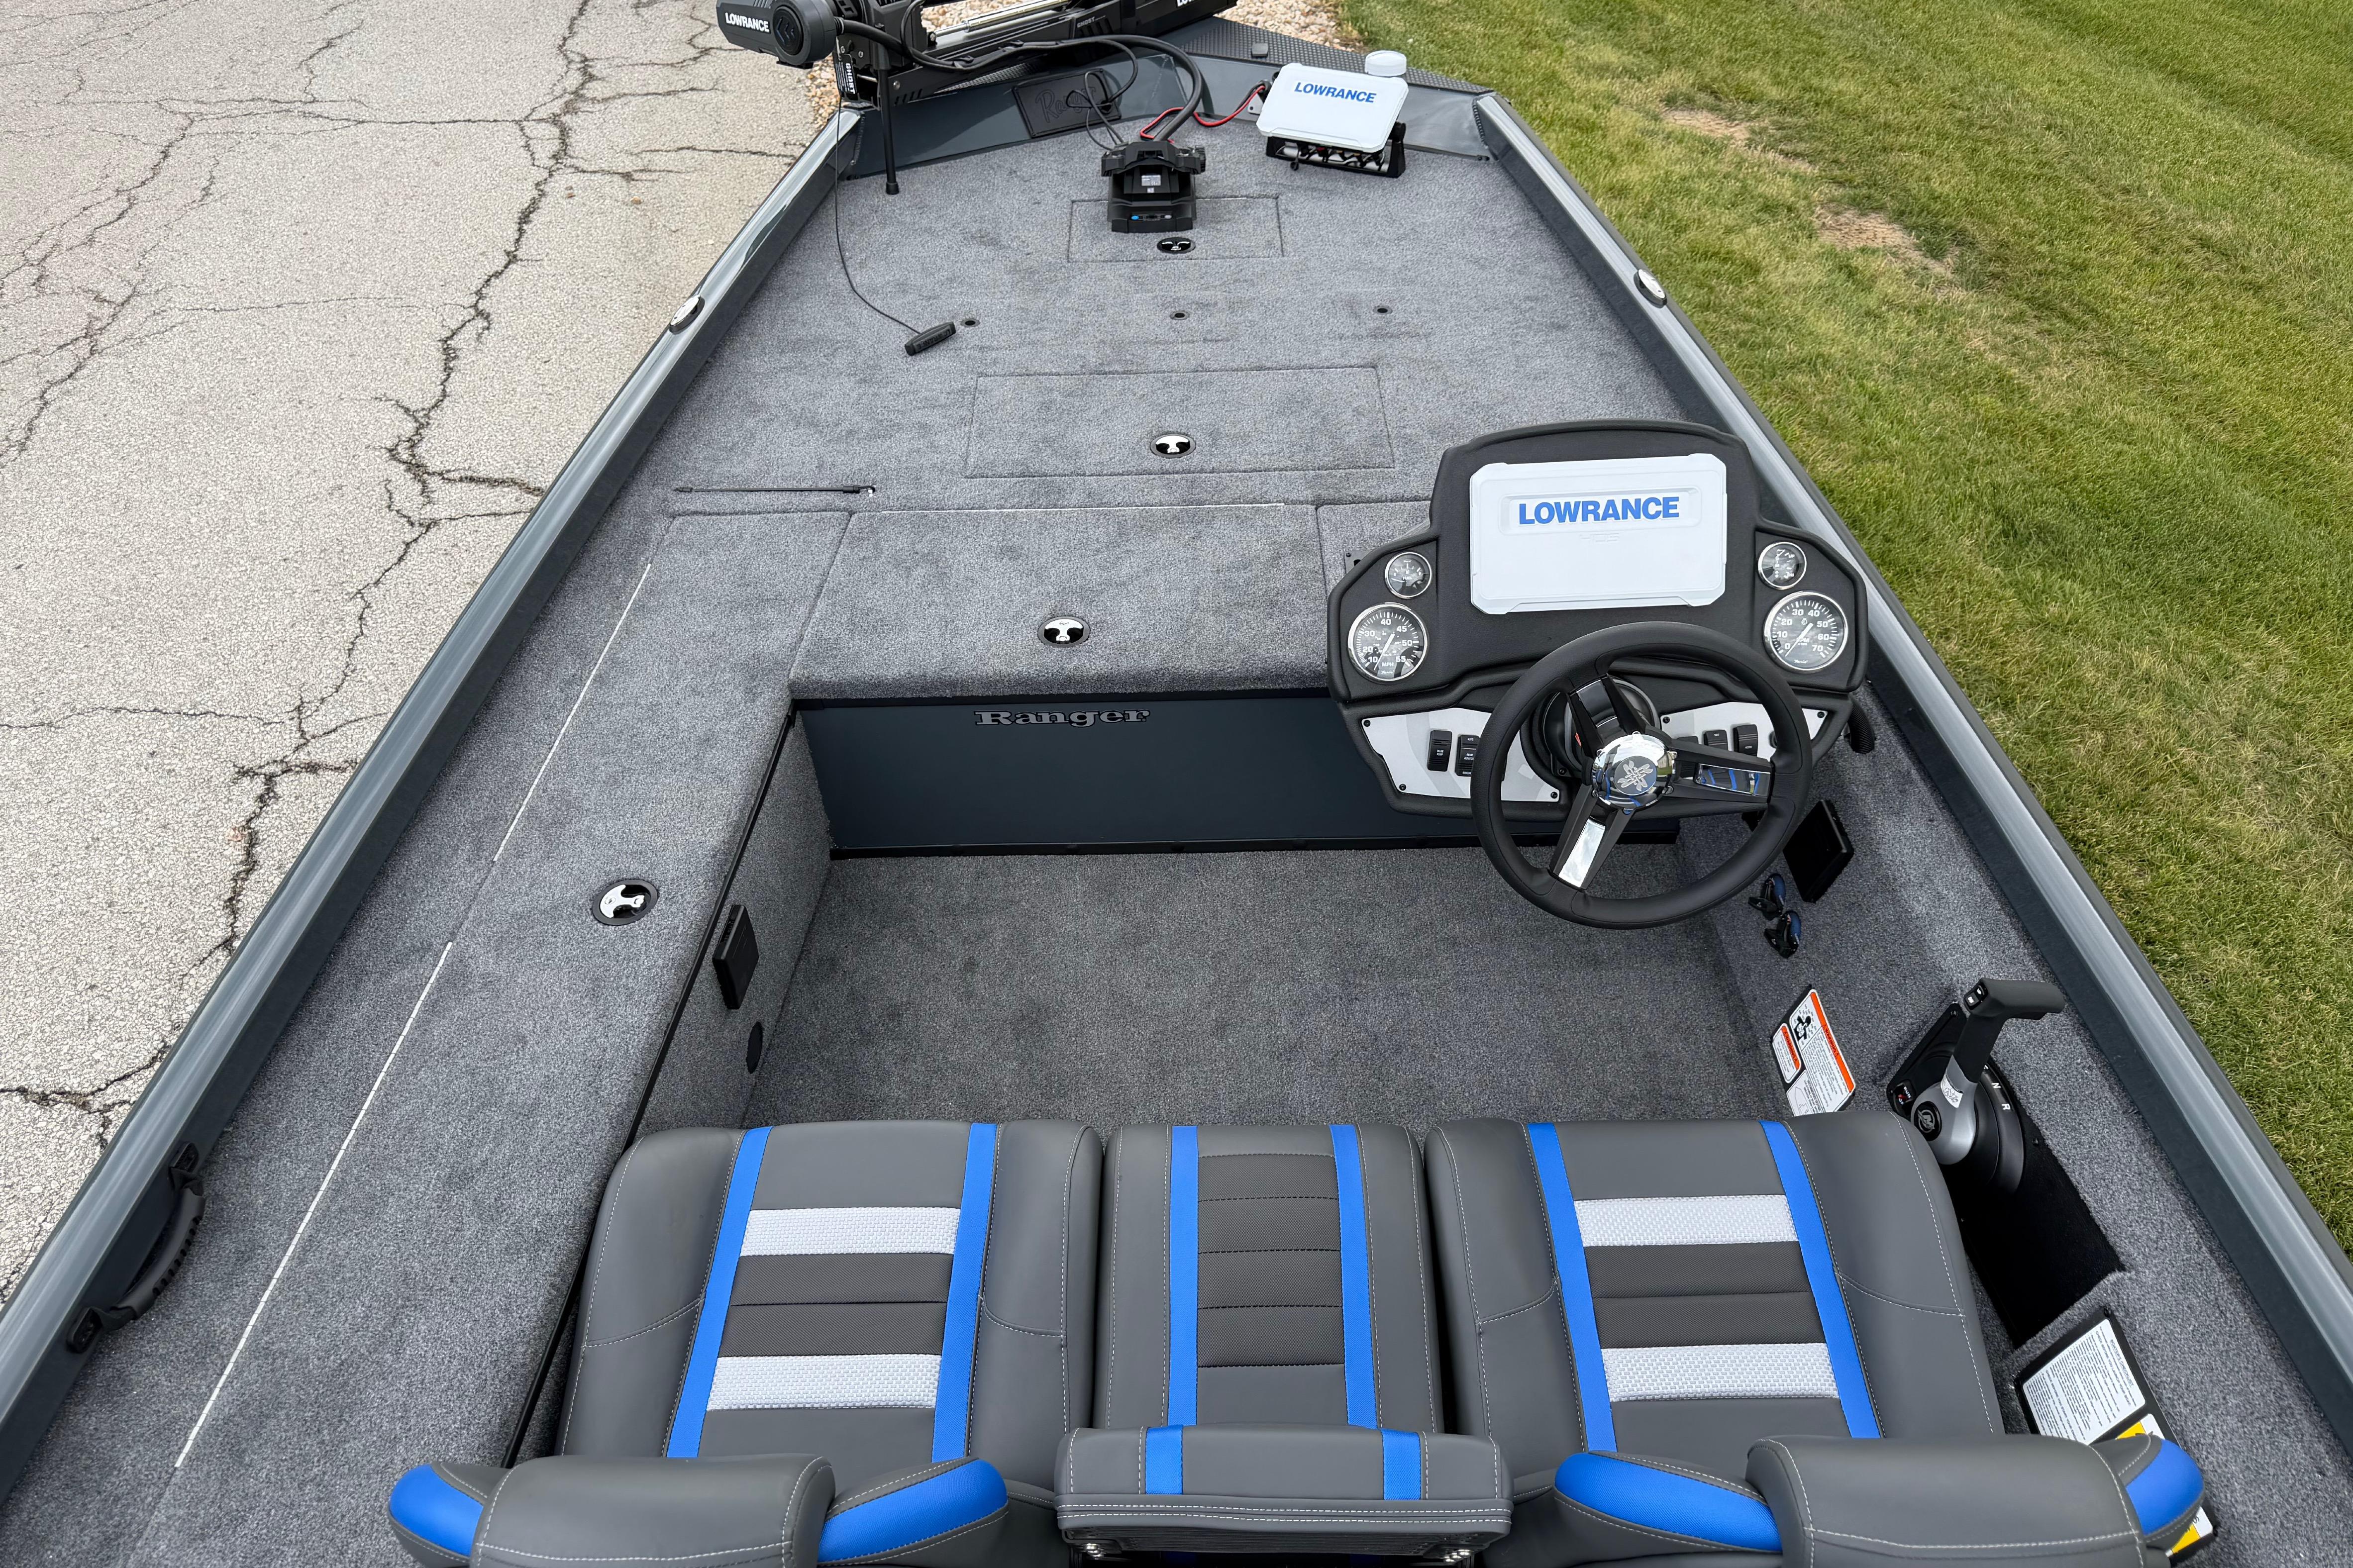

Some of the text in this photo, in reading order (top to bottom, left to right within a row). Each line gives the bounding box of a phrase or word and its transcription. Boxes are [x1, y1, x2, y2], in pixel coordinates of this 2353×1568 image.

[725, 12, 770, 32] LOWRANCE
[1077, 16, 1095, 28] GHOST
[1294, 82, 1377, 103] LOWRANCE
[1519, 496, 1679, 524] LOWRANCE
[974, 709, 1151, 728] Ranger
